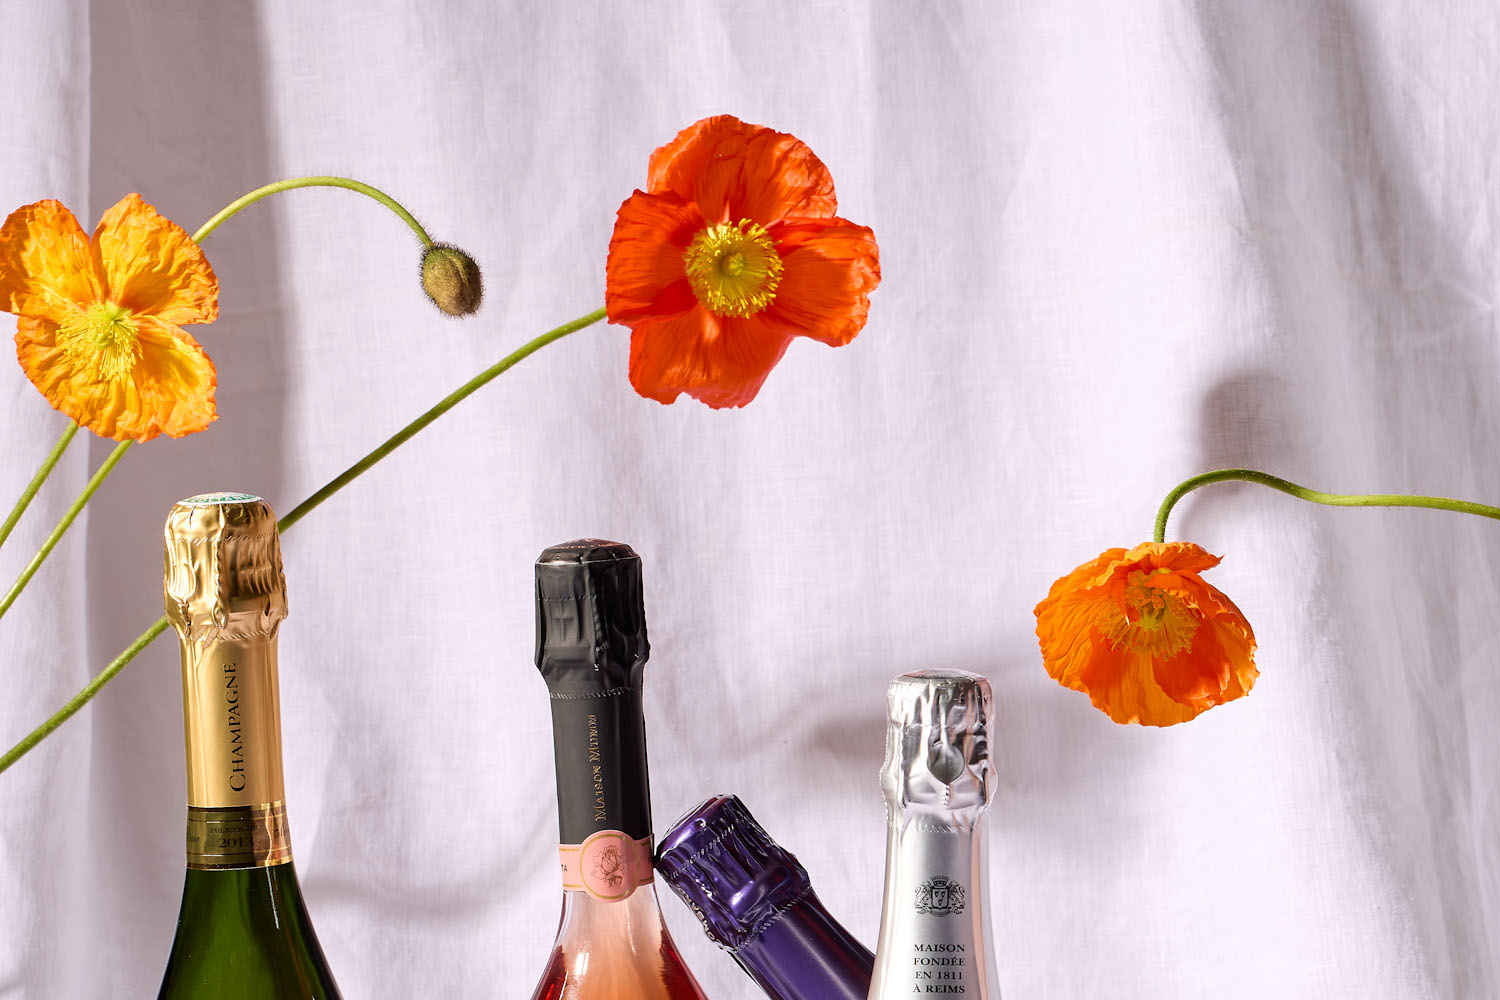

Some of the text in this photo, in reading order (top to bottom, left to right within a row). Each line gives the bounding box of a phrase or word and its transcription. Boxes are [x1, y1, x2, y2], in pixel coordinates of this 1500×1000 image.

[224, 662, 245, 792] CHAMPAGNE
[914, 943, 966, 953] MAISON
[913, 954, 966, 966] FONDÉE
[915, 970, 963, 980] EN 1811
[912, 982, 966, 994] À REIMS
